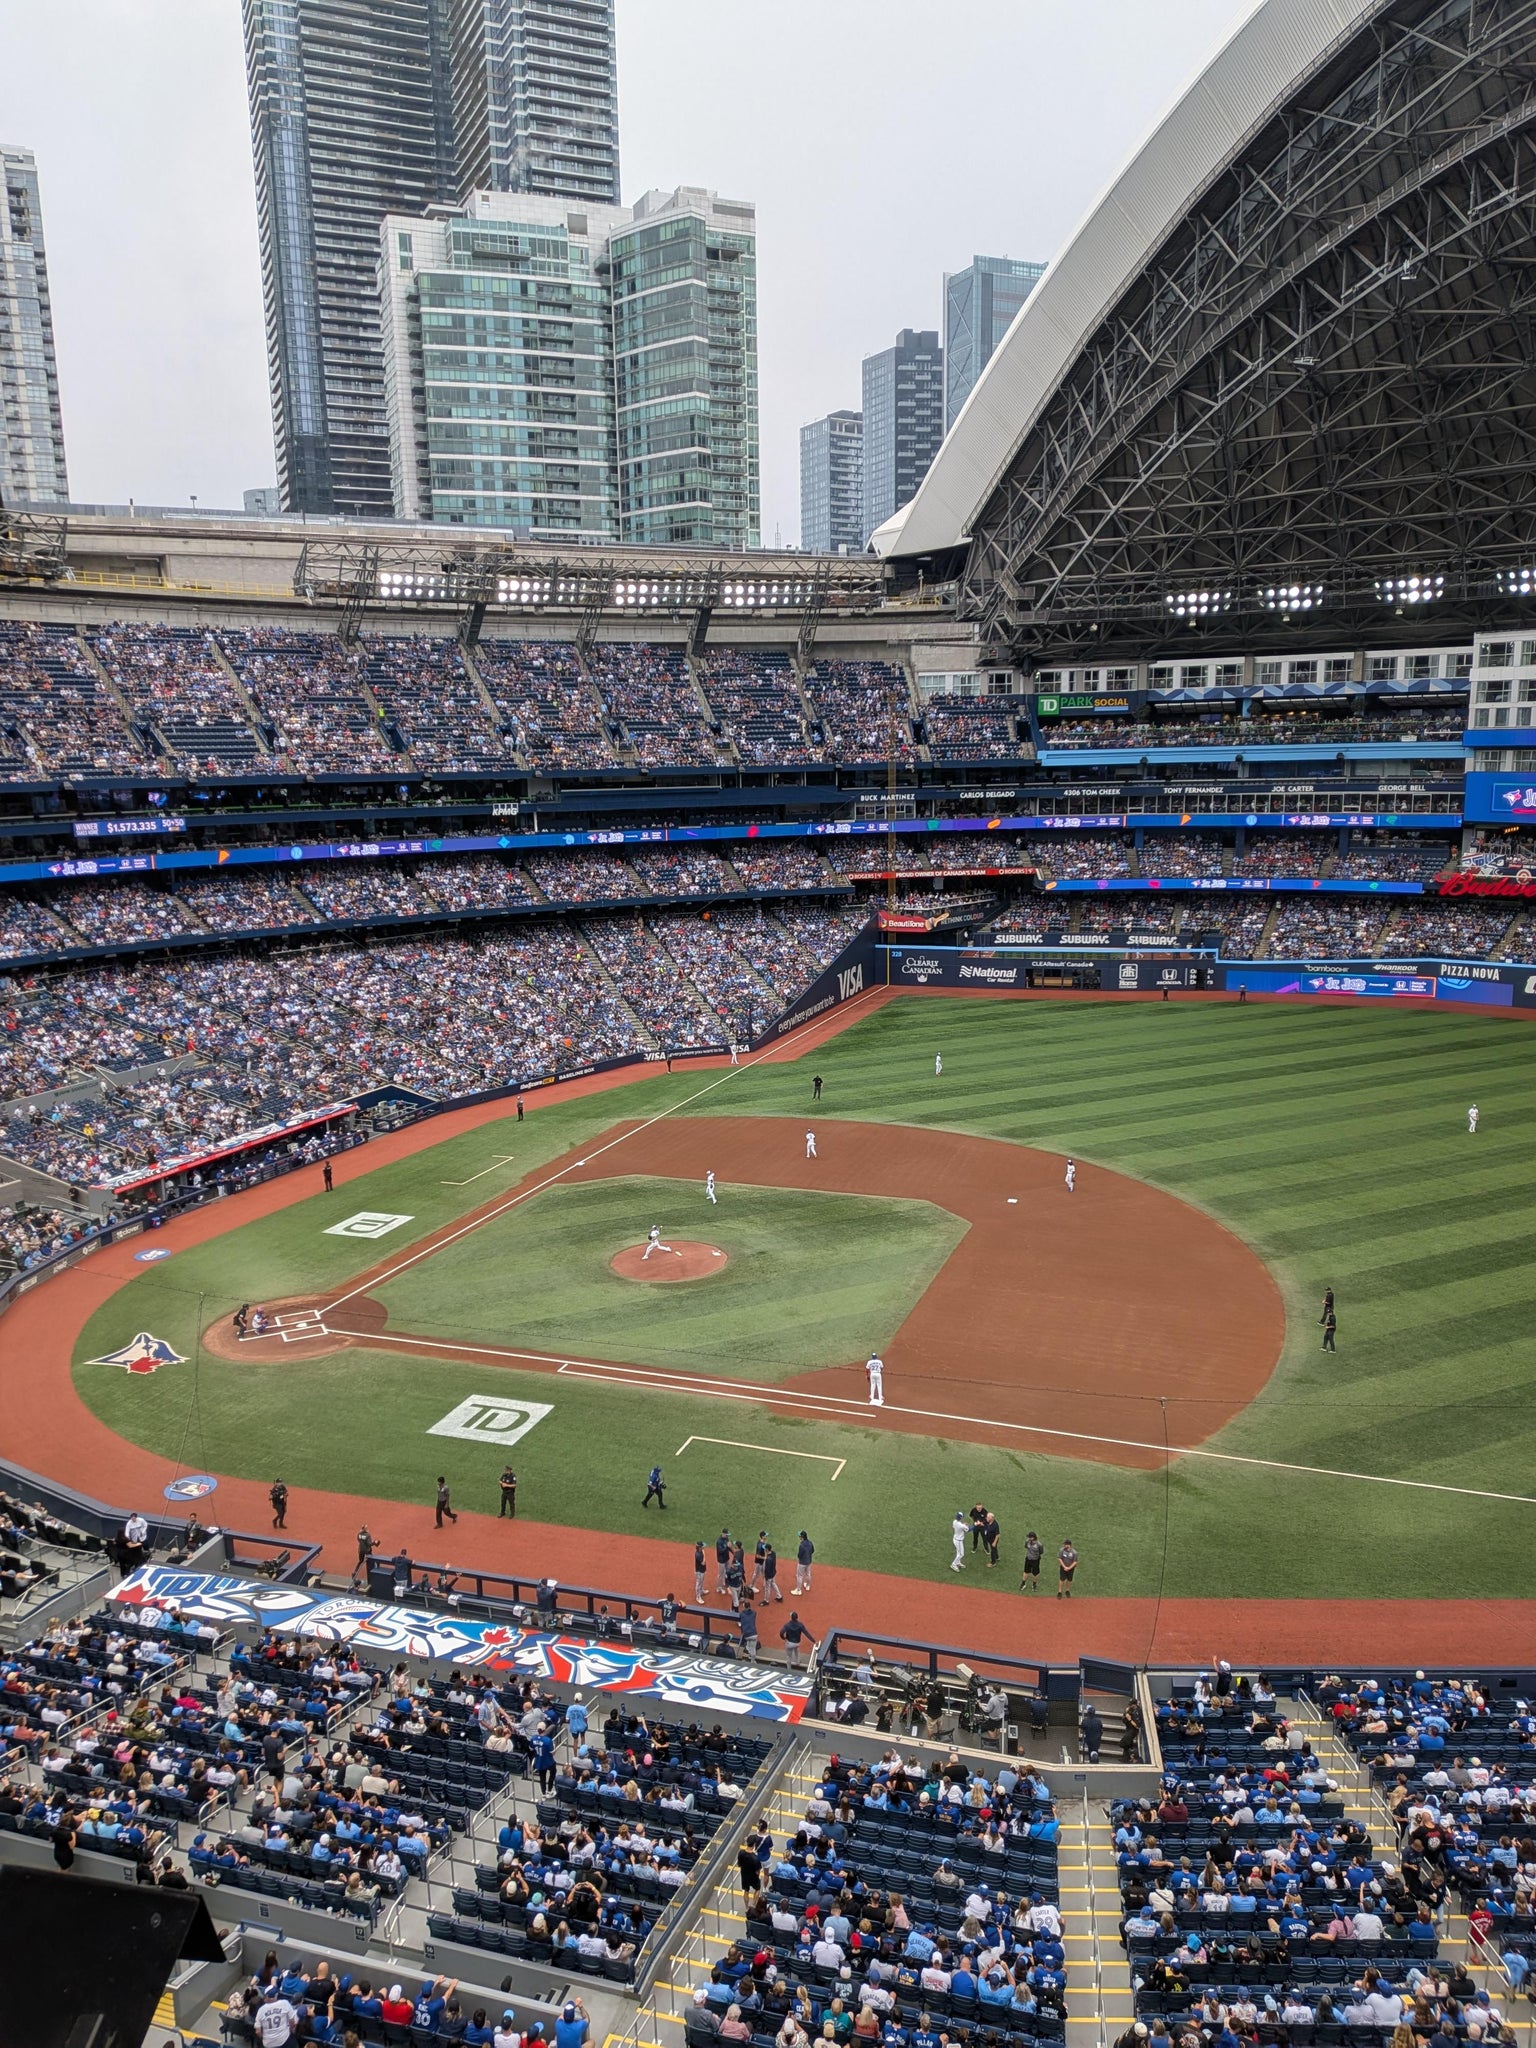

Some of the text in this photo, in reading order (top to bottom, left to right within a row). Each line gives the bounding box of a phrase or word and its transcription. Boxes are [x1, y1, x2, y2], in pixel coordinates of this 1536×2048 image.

[1061, 696, 1093, 706] PARK
[1094, 698, 1128, 706] SOCIAL
[1184, 786, 1224, 794] FERNANDEZ
[860, 794, 878, 802] BUCK
[994, 934, 1043, 944] SUBWAY
[1060, 935, 1110, 944] SUBWAY
[1126, 936, 1178, 945] SUBWAY
[972, 968, 1017, 978] National
[1440, 964, 1500, 980] PIZZA NOVA
[837, 963, 863, 1000] VISA
[778, 1011, 806, 1033] everywhere
[804, 1009, 814, 1020] you
[813, 1002, 824, 1013] want
[829, 995, 835, 1005] be
[644, 1052, 666, 1061] VISA
[460, 1403, 530, 1432] TD
[144, 1611, 156, 1624] 27
[1036, 1909, 1049, 1917] CARTER
[1036, 1917, 1054, 1929] 29
[267, 2015, 281, 2029] 19
[415, 2010, 431, 2026] 30
